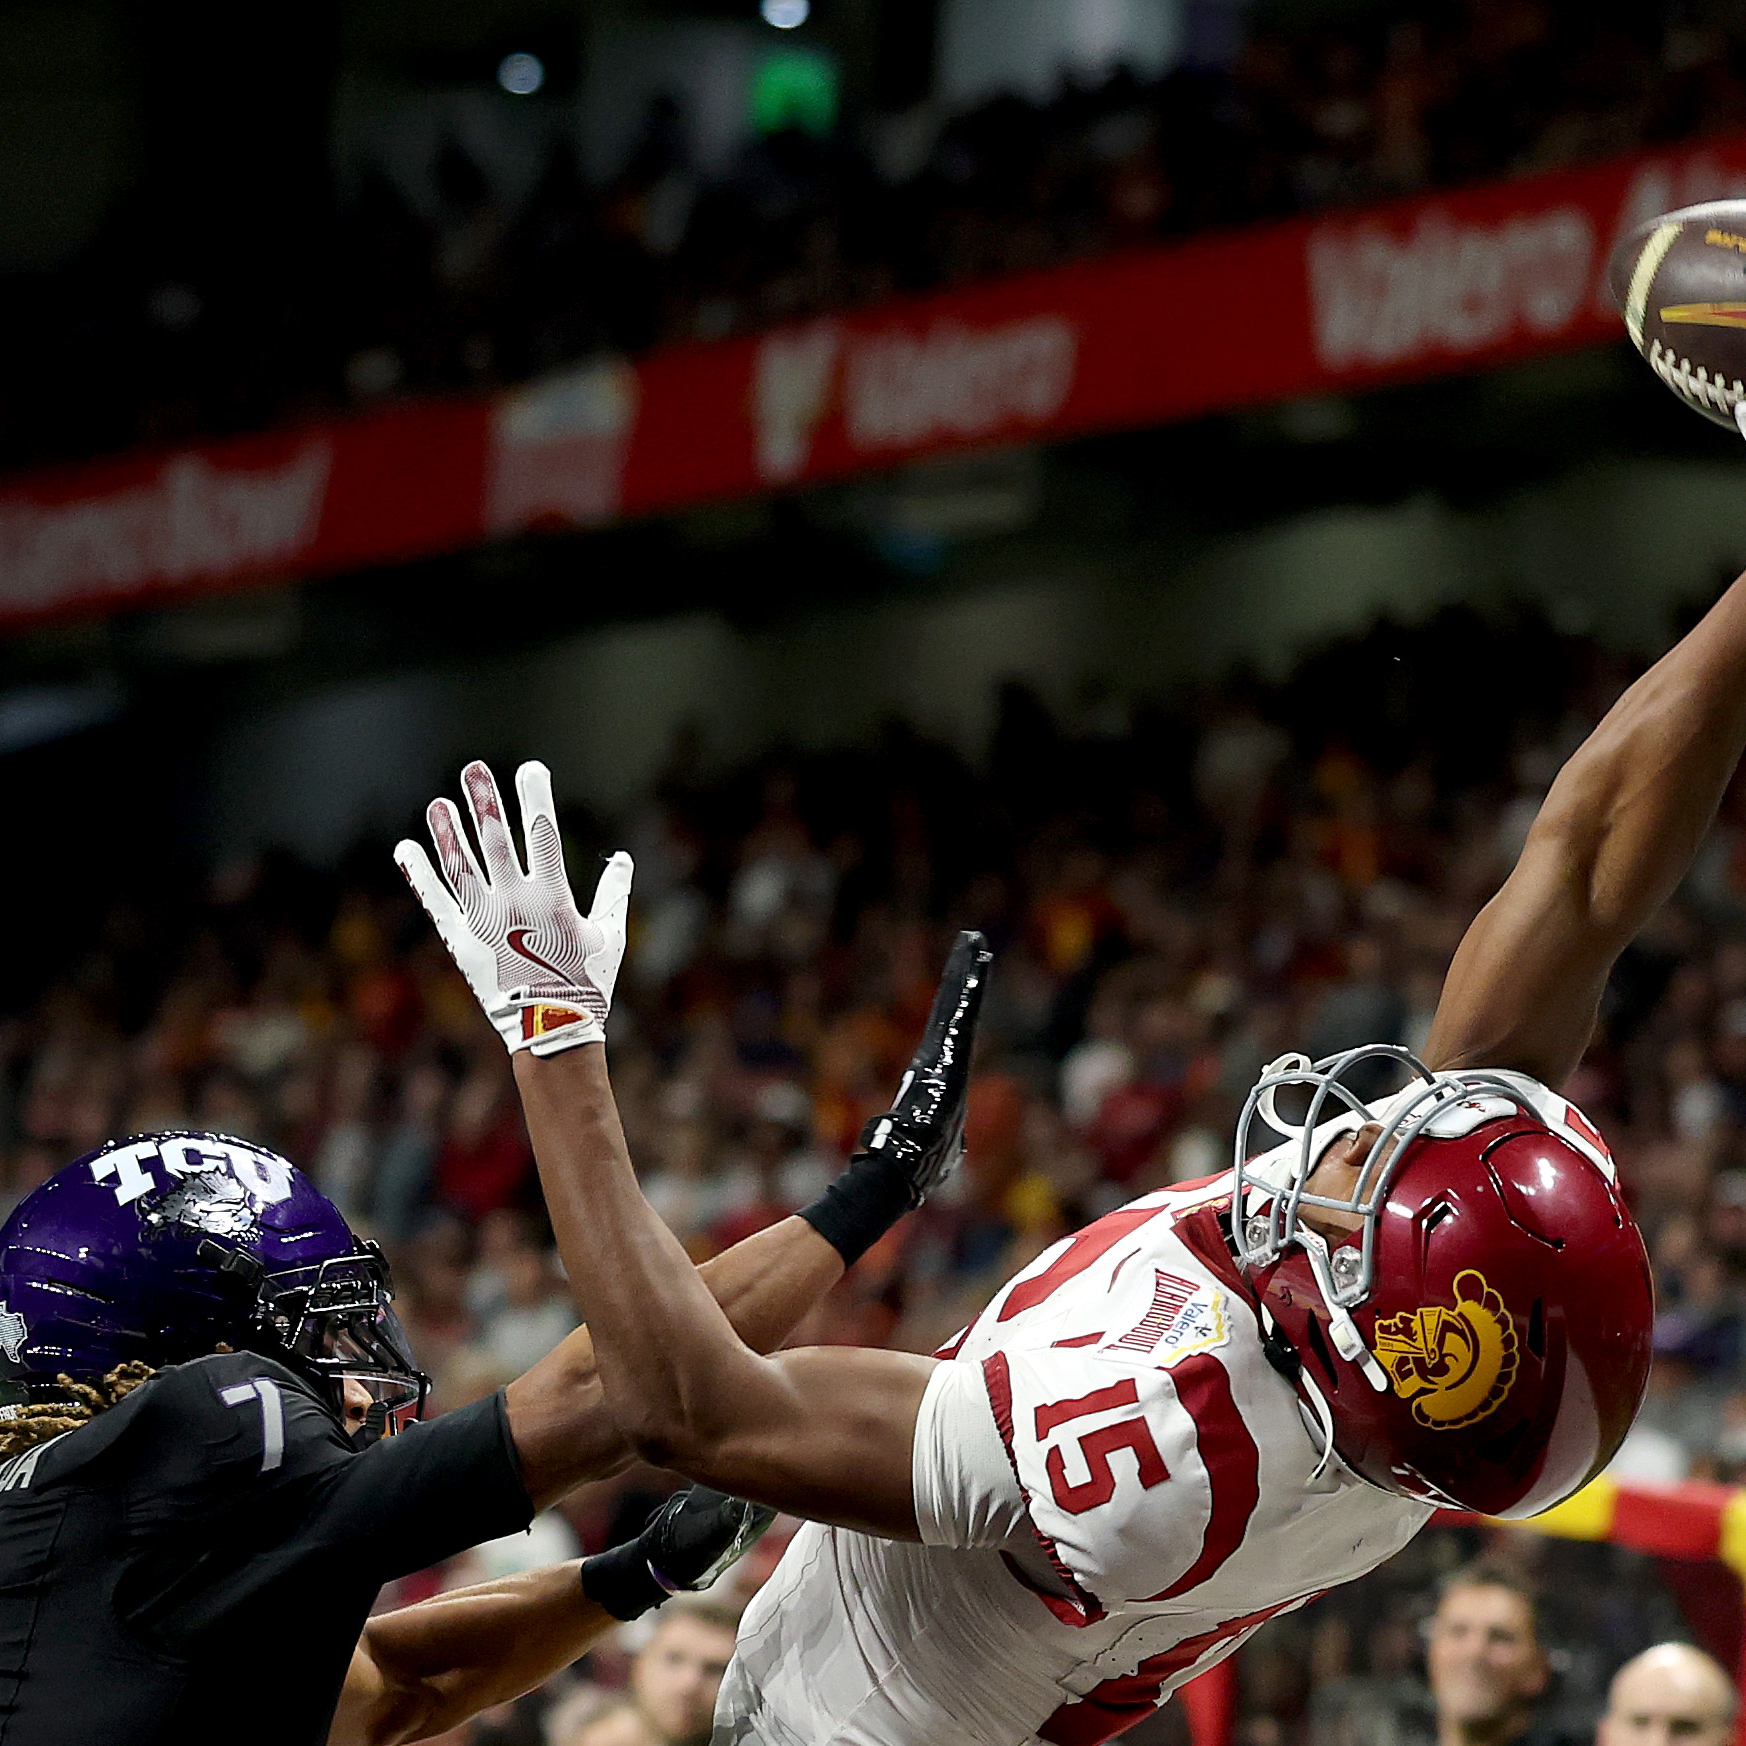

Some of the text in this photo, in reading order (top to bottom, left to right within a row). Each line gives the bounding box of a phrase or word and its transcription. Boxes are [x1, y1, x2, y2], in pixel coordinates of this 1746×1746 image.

[89, 1137, 295, 1206] TCU
[1165, 1302, 1209, 1348] Valero
[216, 1376, 285, 1471] 7
[1032, 1377, 1172, 1515] 15
